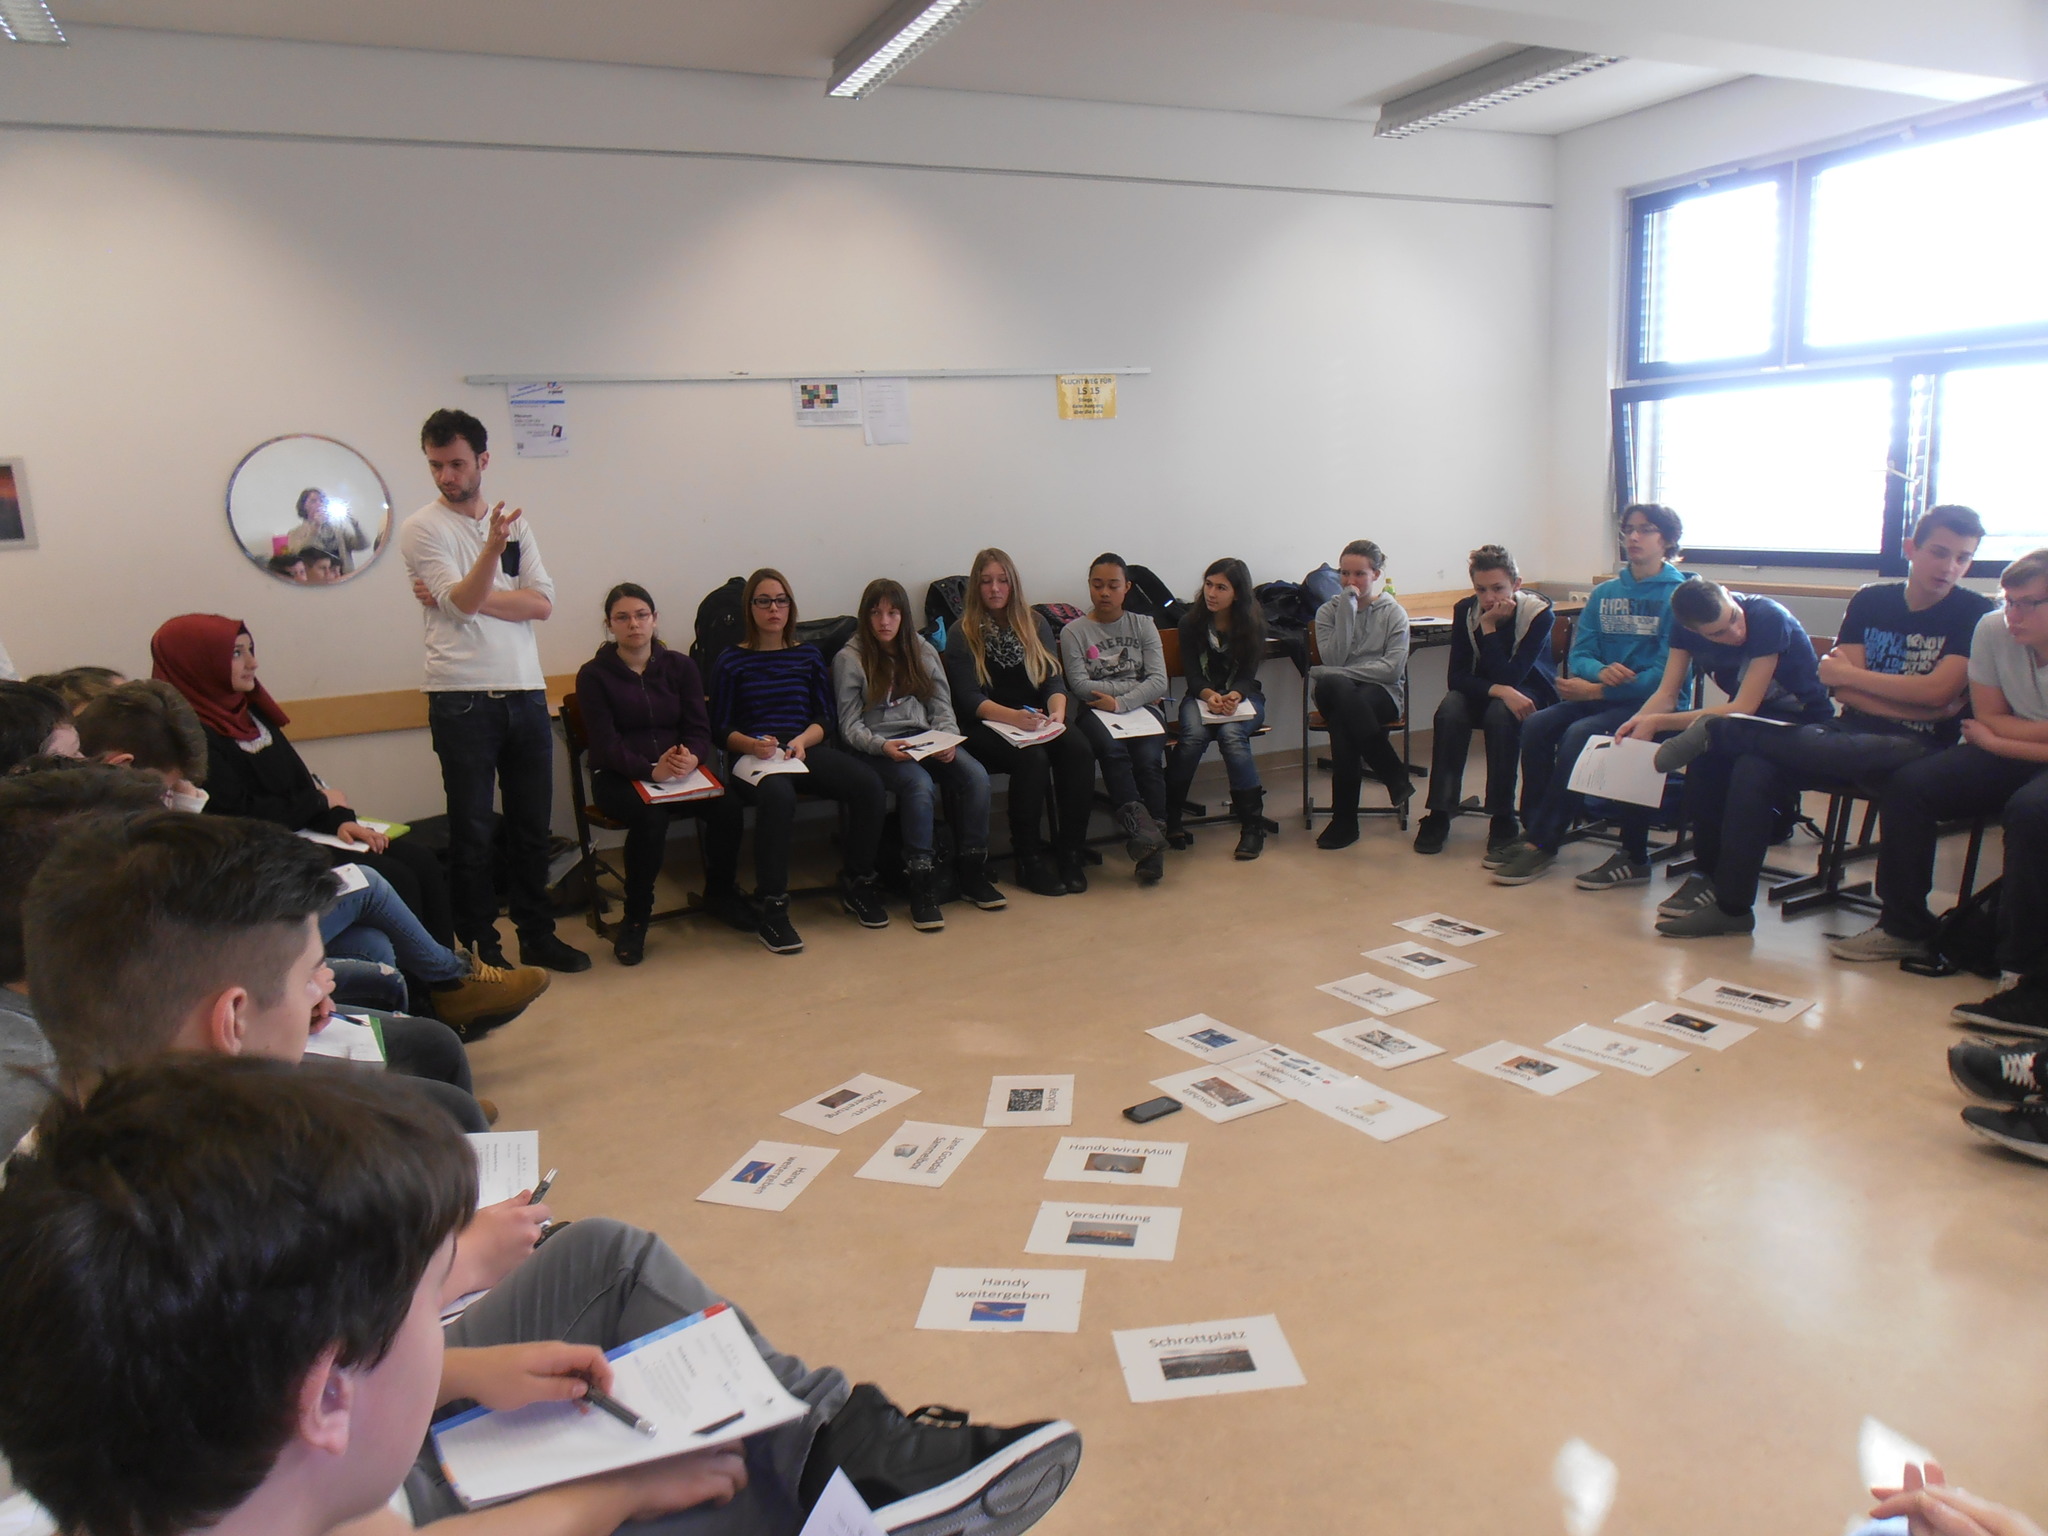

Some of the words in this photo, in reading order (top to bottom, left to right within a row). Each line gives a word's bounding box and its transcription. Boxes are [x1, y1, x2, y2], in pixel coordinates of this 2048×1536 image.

[1077, 386, 1088, 395] LS
[1090, 386, 1100, 395] 15
[1094, 636, 1141, 653] NERDS
[1177, 1036, 1212, 1053] Software
[825, 1089, 883, 1119] Aufbereitung
[909, 1136, 946, 1170] Sammelbox
[1069, 1144, 1109, 1153] Handy
[1112, 1146, 1142, 1154] wird
[1144, 1147, 1172, 1156] Müll
[753, 1157, 797, 1194] weitergeben
[779, 1167, 807, 1187] Handy
[1066, 1211, 1152, 1222] Verschiffung
[981, 1278, 1030, 1288] Handy
[955, 1290, 1050, 1300] weitergeben
[1149, 1331, 1247, 1347] Schrottplatz
